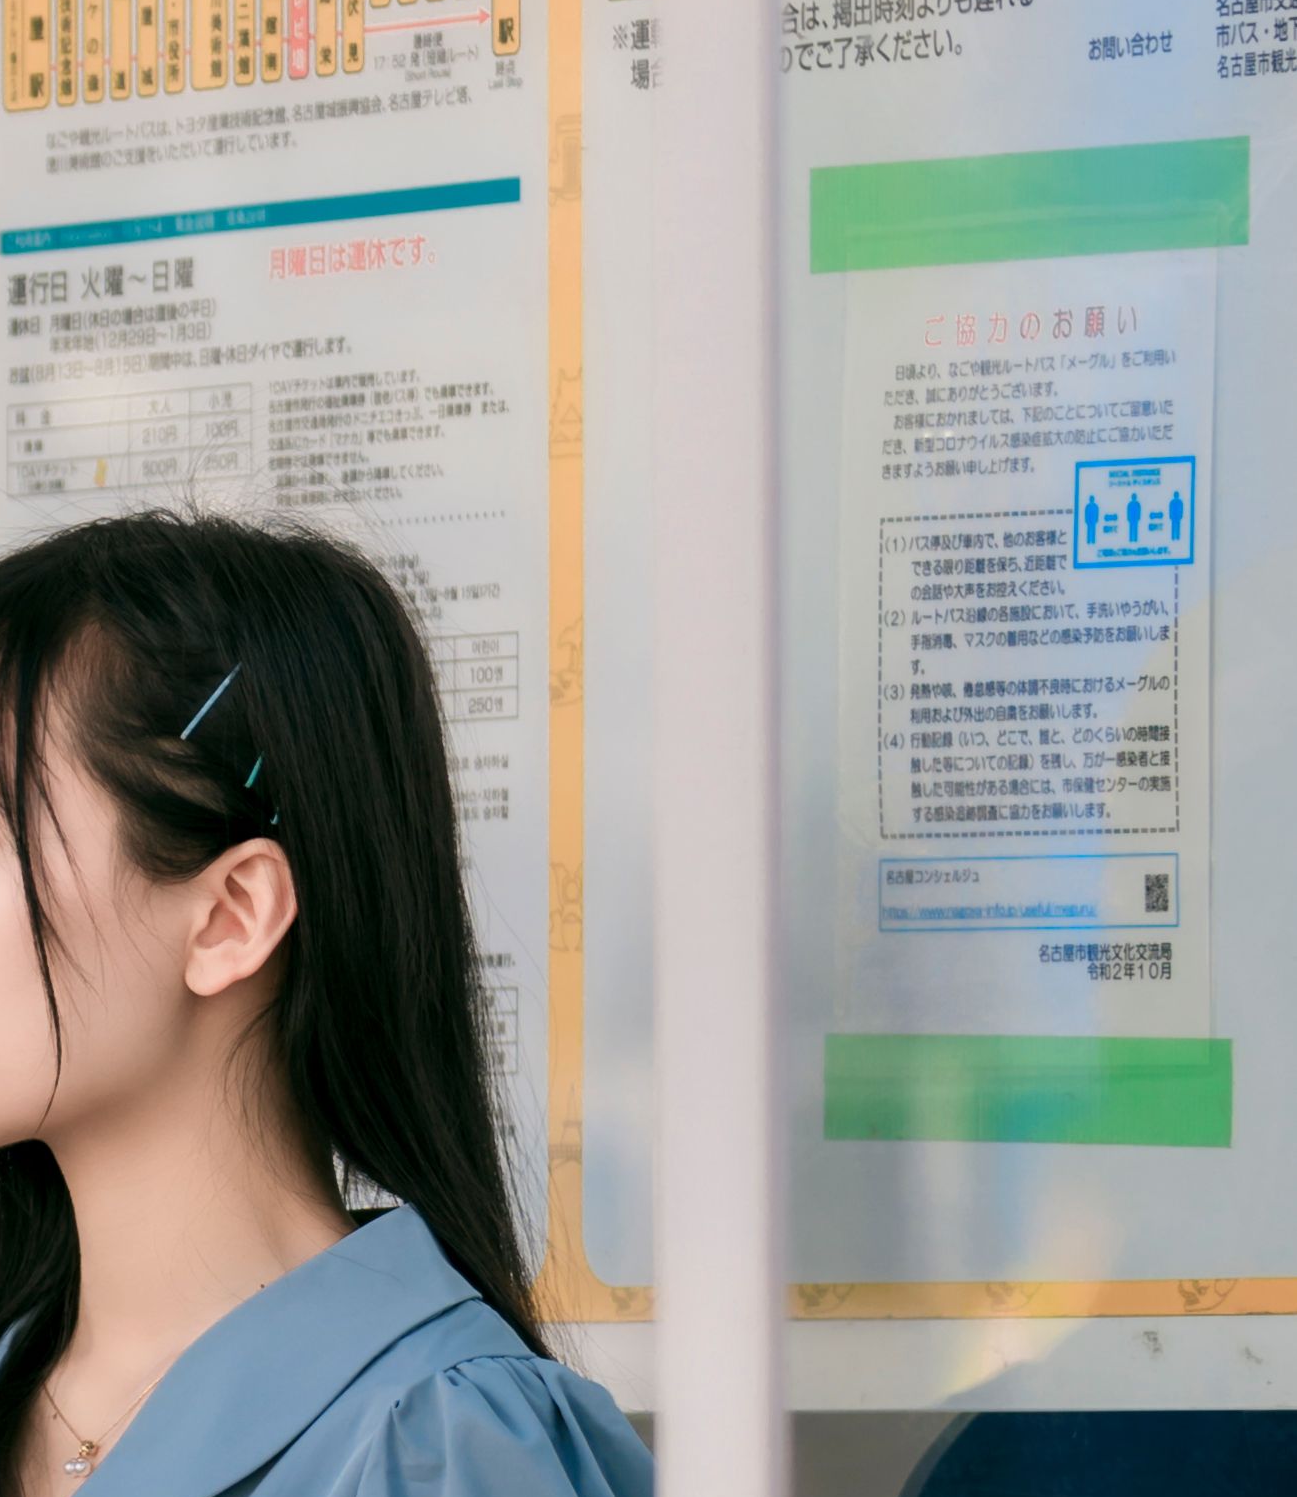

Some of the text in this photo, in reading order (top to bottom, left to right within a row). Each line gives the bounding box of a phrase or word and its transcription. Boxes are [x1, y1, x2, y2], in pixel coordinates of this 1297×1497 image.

[1087, 31, 1174, 62] お問い合わせ
[269, 234, 436, 280] 月曜日は運休です。
[7, 270, 68, 307] 運行日
[923, 304, 1138, 348] ご協力のお願い
[886, 867, 981, 886] 名古屋コンシェルジュ
[1038, 941, 1173, 963] 名古屋市観光文化交流局
